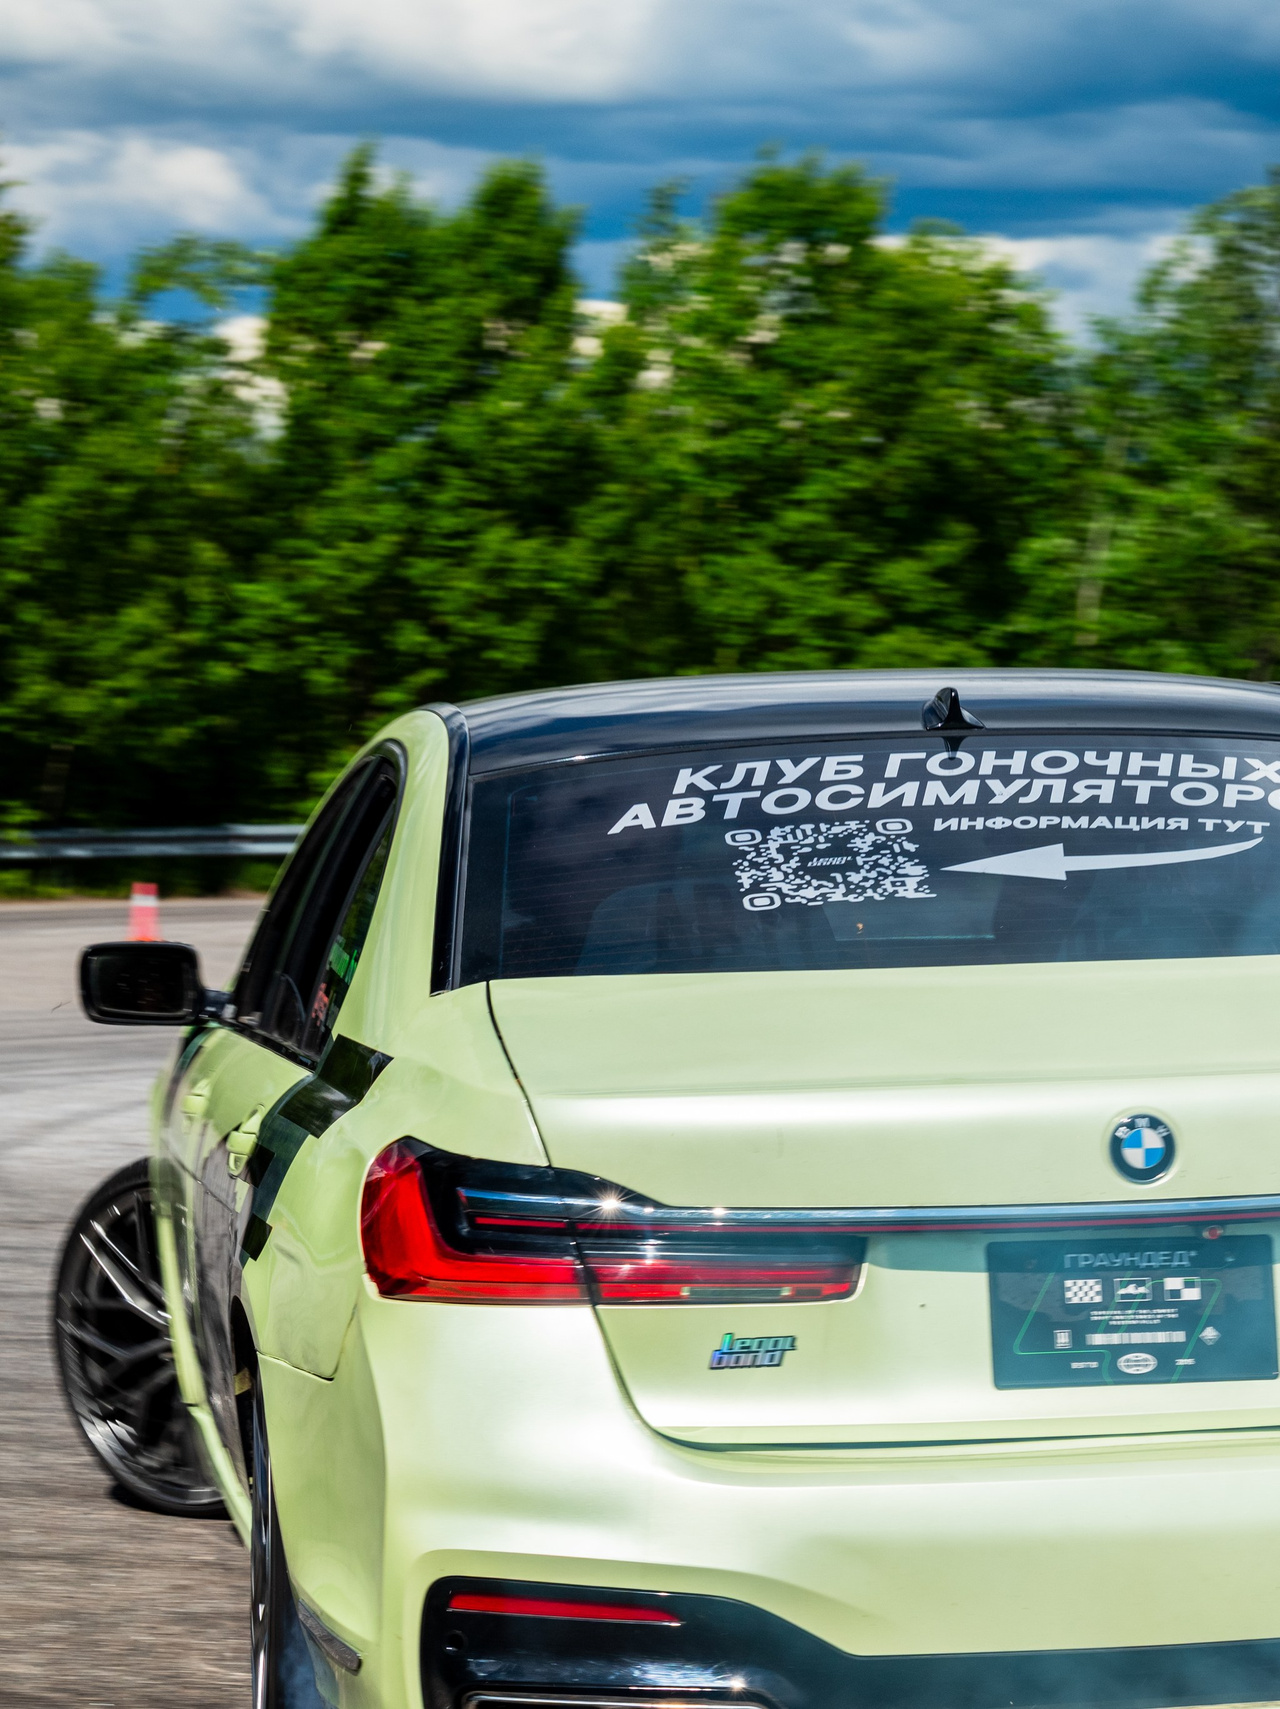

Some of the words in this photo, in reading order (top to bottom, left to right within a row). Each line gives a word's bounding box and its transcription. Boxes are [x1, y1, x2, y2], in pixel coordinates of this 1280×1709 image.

[672, 754, 863, 795] КЛУБ
[933, 815, 1189, 832] ИНФОРМАЦИЯ
[1198, 817, 1270, 835] ТУТ
